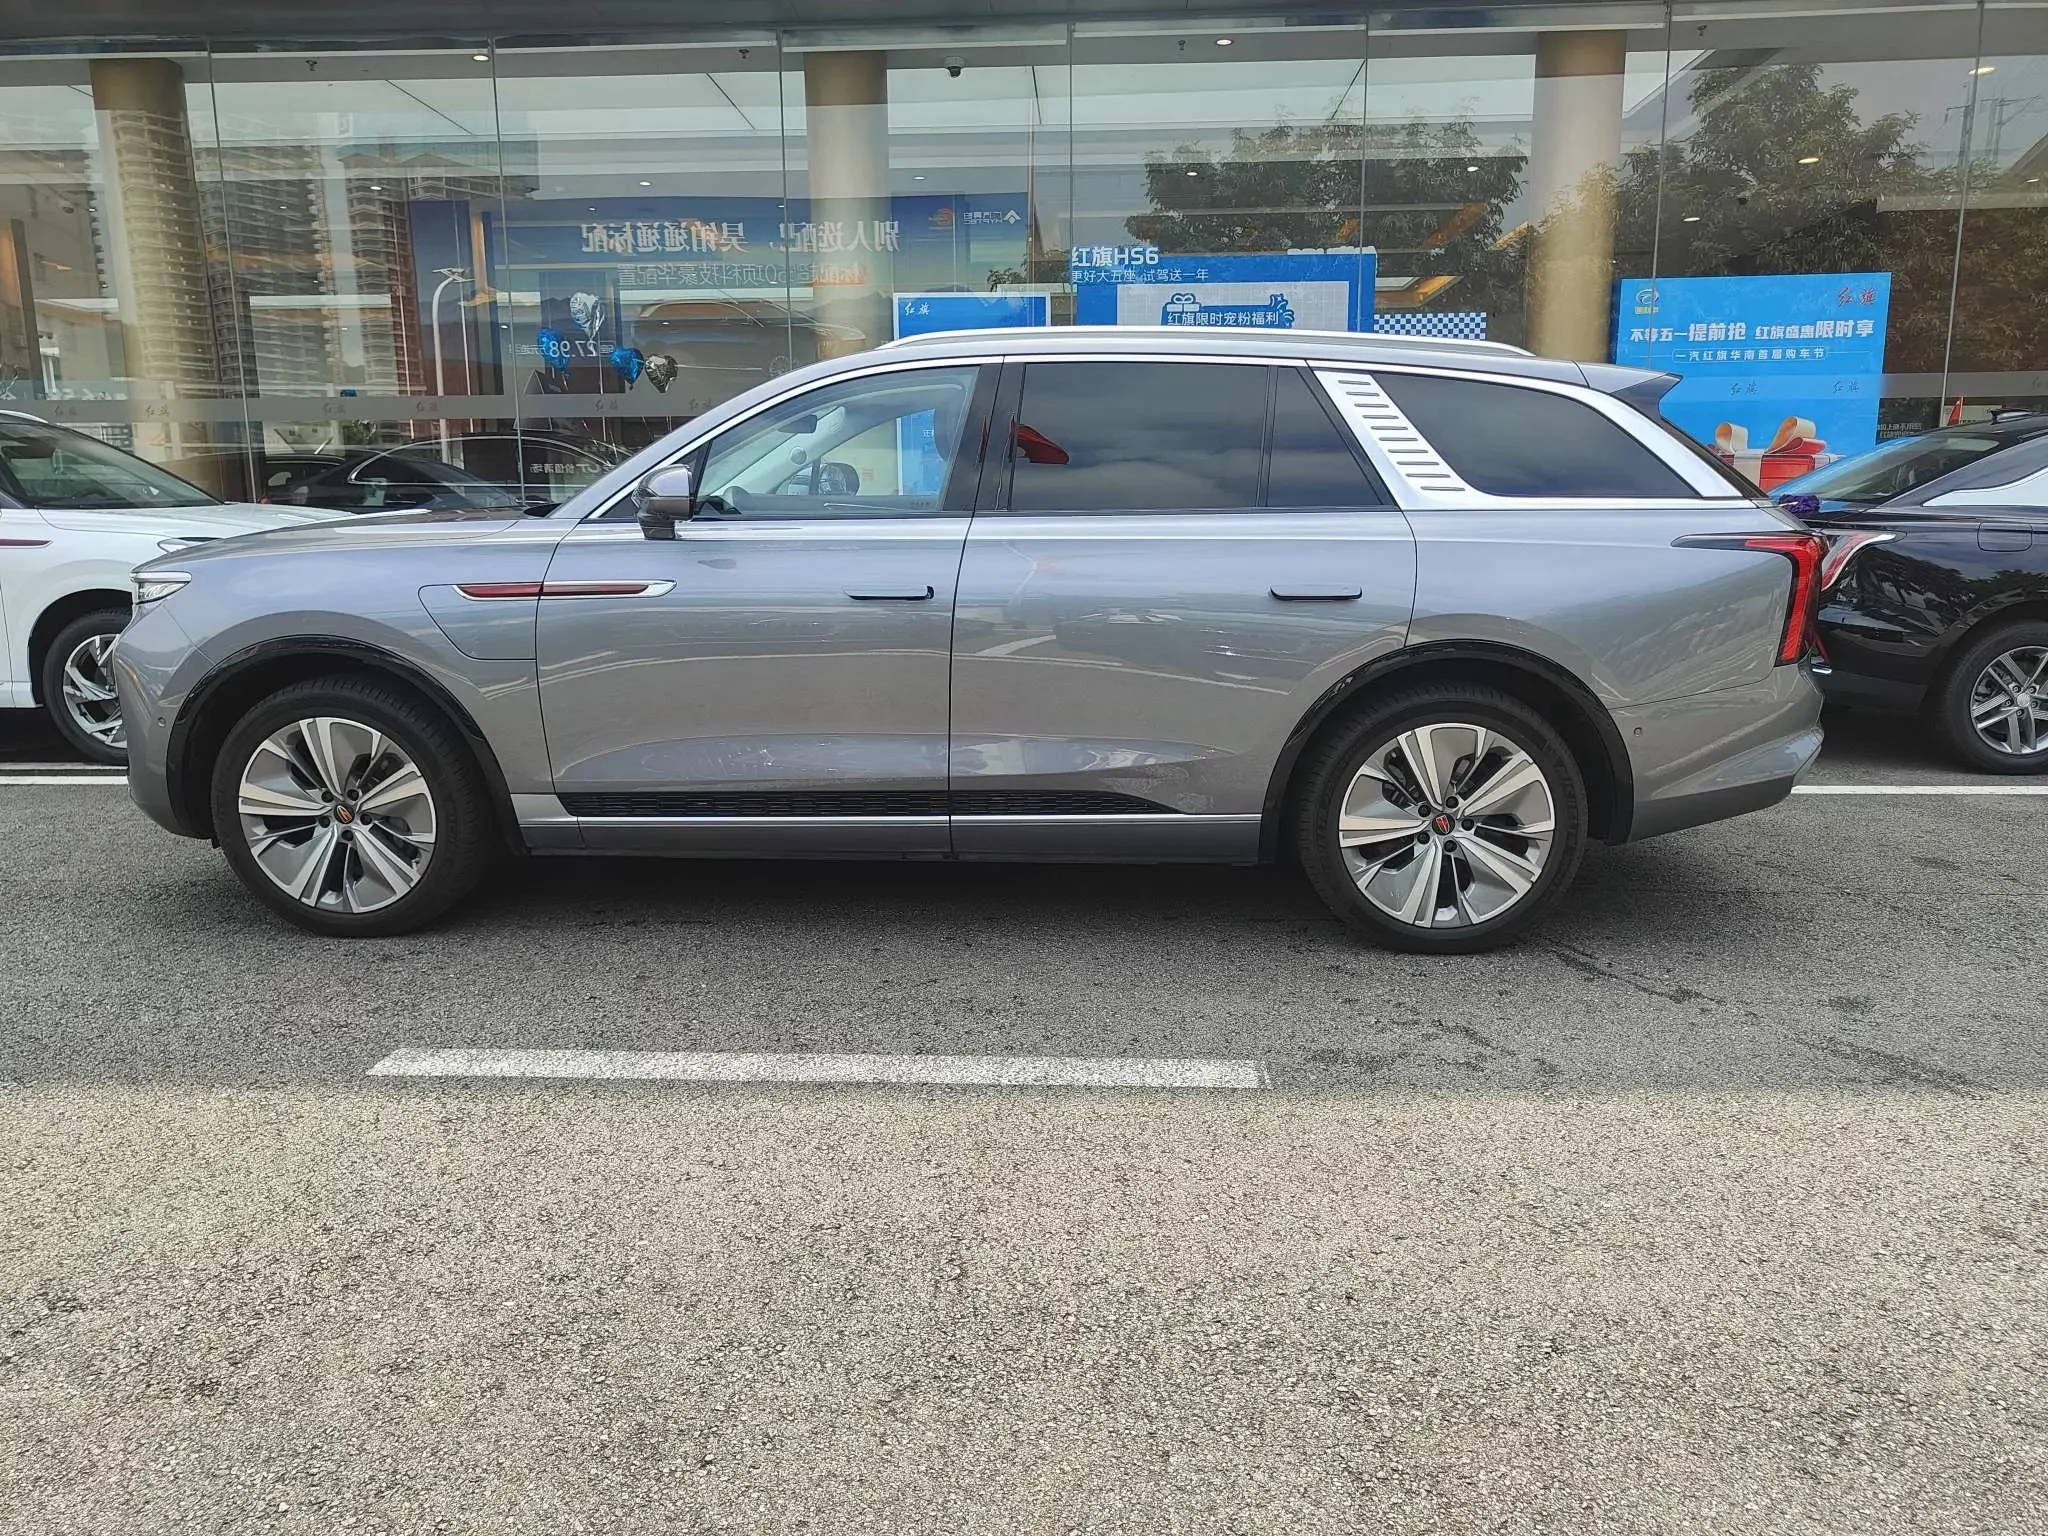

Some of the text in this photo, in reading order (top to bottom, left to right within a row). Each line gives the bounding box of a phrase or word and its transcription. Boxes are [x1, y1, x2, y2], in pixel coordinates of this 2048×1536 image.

[1071, 247, 1159, 267] 红旗HS6
[1071, 268, 1209, 283] 更好大五座 试驾送一年
[1167, 311, 1279, 326] 红旗限时宠粉福利
[1630, 319, 1875, 342] 不等五一提前抢 红旗盛惠限时享
[1675, 348, 1825, 361] 一汽红旗华南首届购车节
